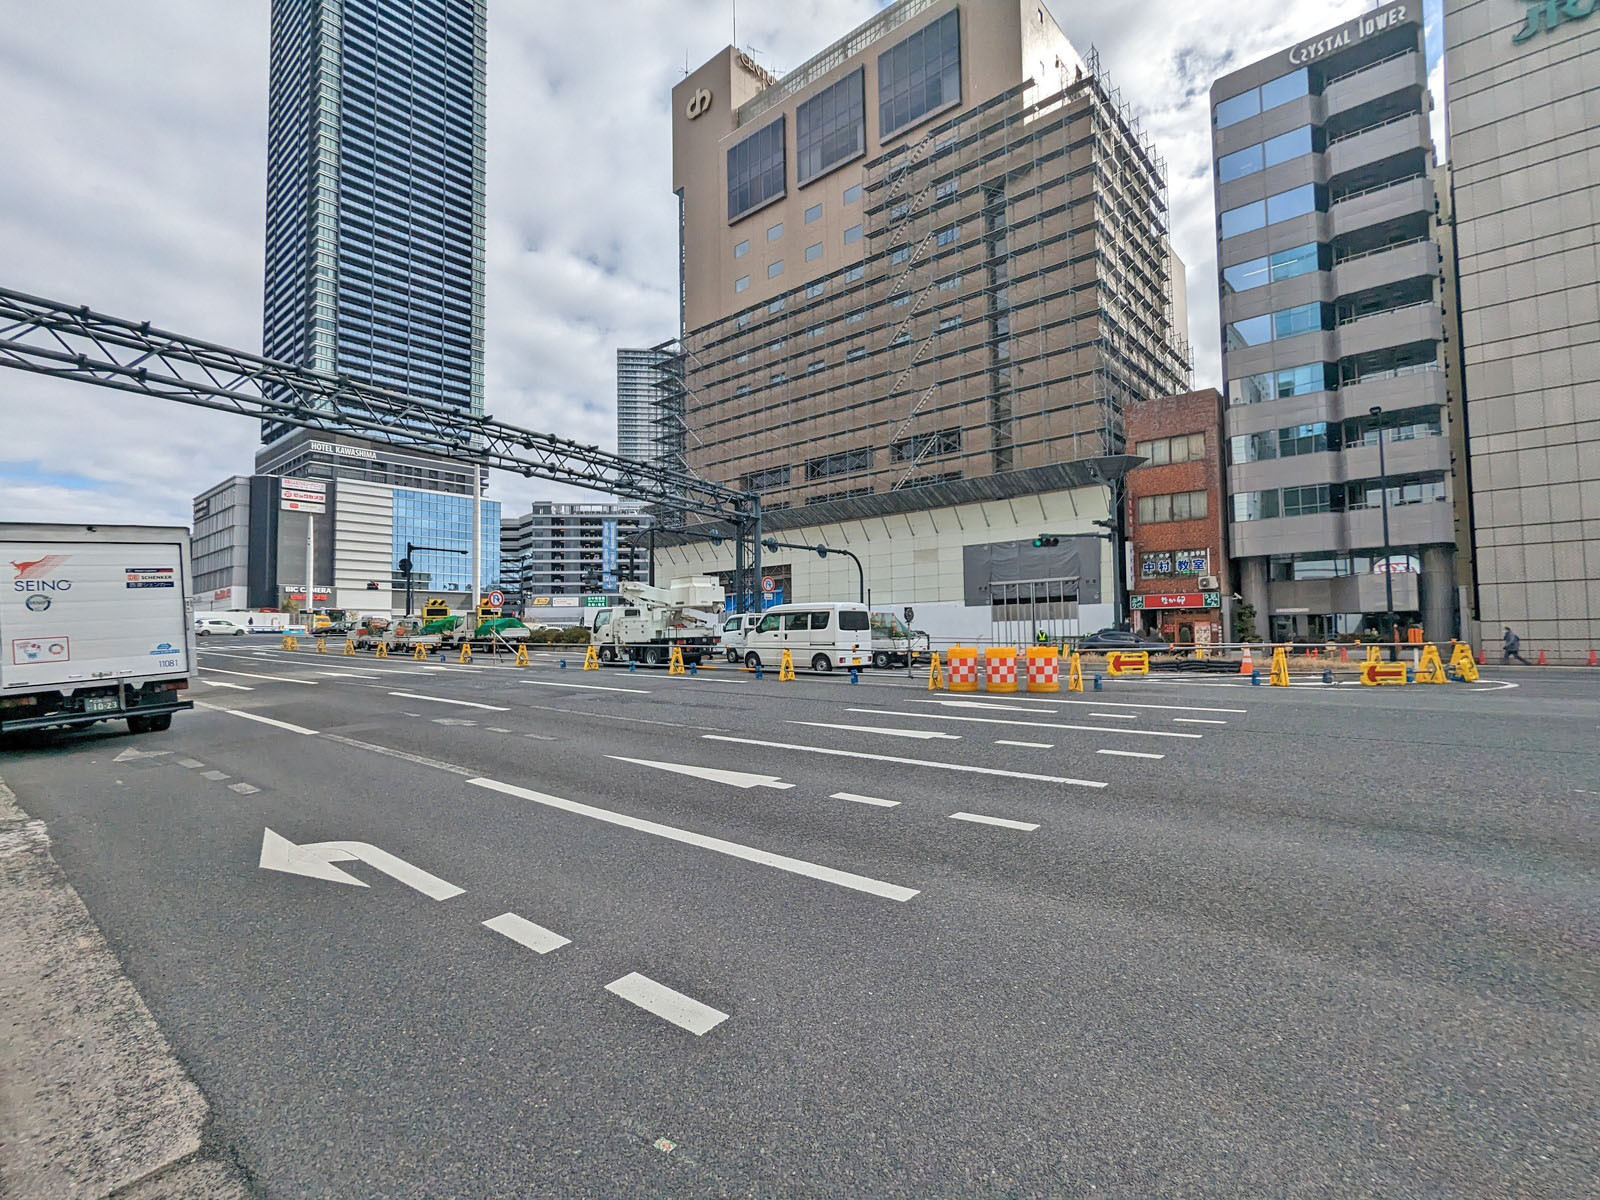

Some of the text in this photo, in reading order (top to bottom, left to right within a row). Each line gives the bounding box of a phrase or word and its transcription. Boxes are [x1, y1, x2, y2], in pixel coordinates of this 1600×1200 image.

[311, 442, 377, 460] HOTEL KAWASHIMA
[159, 659, 178, 668] 11081
